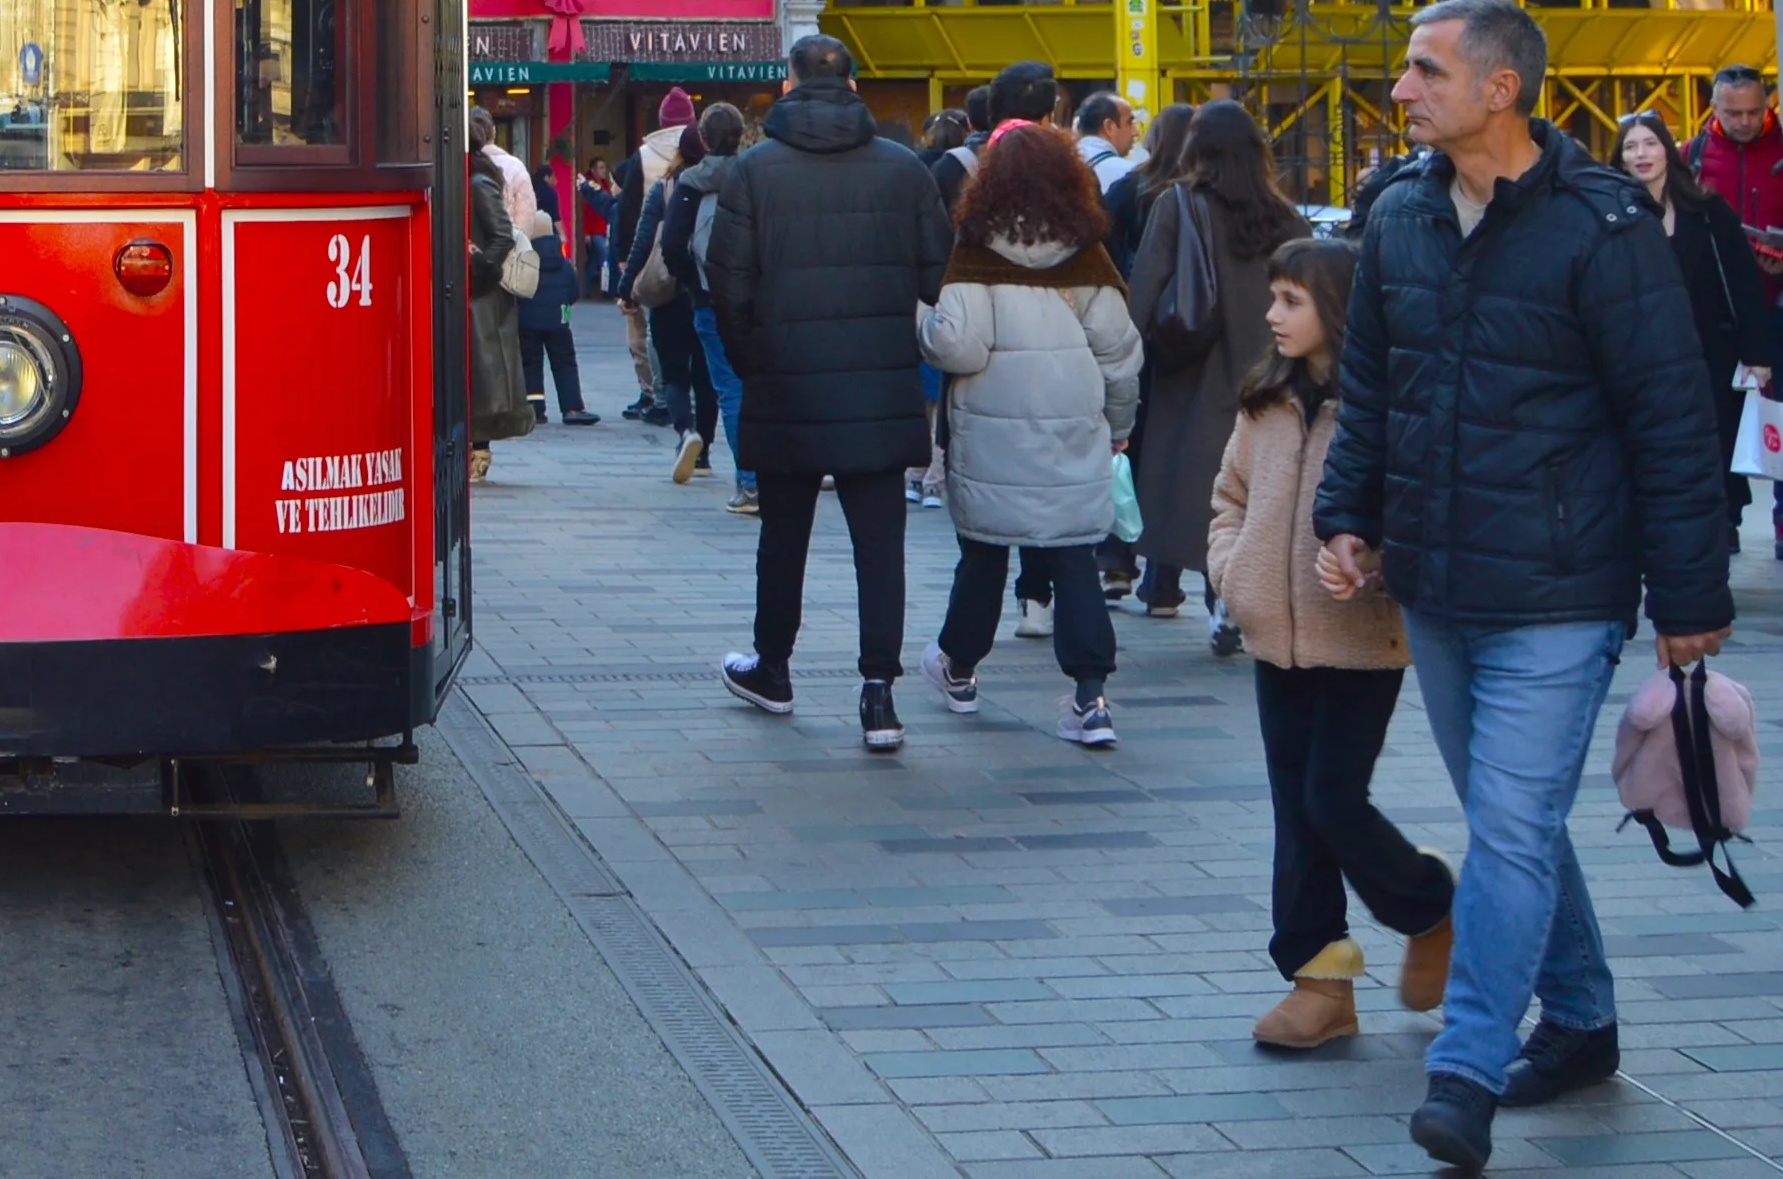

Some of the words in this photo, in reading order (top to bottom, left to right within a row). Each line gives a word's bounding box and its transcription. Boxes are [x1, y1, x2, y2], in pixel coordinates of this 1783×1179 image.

[628, 32, 748, 53] VITAVIEN
[707, 64, 787, 80] VITAVIEN
[326, 233, 374, 309] 34
[281, 454, 364, 492] ASILMAK
[365, 447, 403, 488] YASAK
[275, 498, 302, 534] VE
[304, 487, 405, 533] TEHLIKELIDIR
